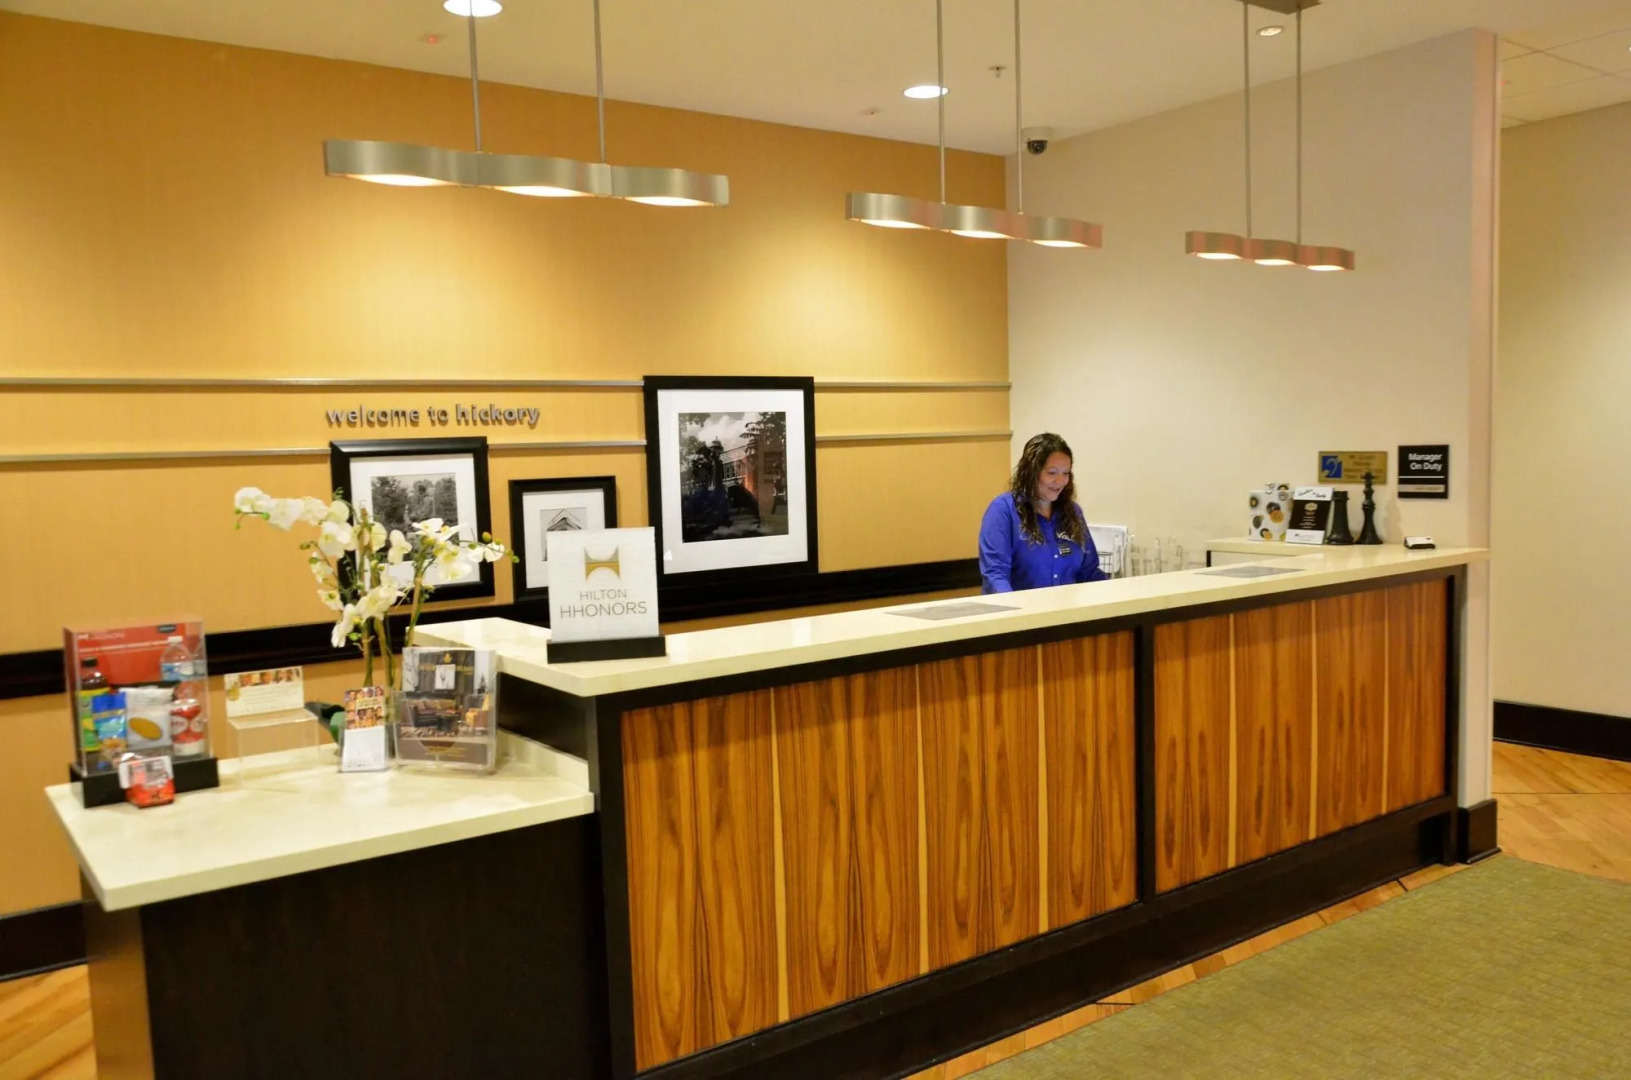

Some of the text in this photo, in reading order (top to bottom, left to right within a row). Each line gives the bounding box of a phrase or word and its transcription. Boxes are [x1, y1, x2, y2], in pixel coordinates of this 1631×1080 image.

[326, 403, 540, 429] welcome to hickory
[1408, 452, 1443, 462] Manager
[1410, 462, 1443, 471] On Duty
[579, 588, 627, 601] HILTON
[560, 601, 648, 619] HHONORS
